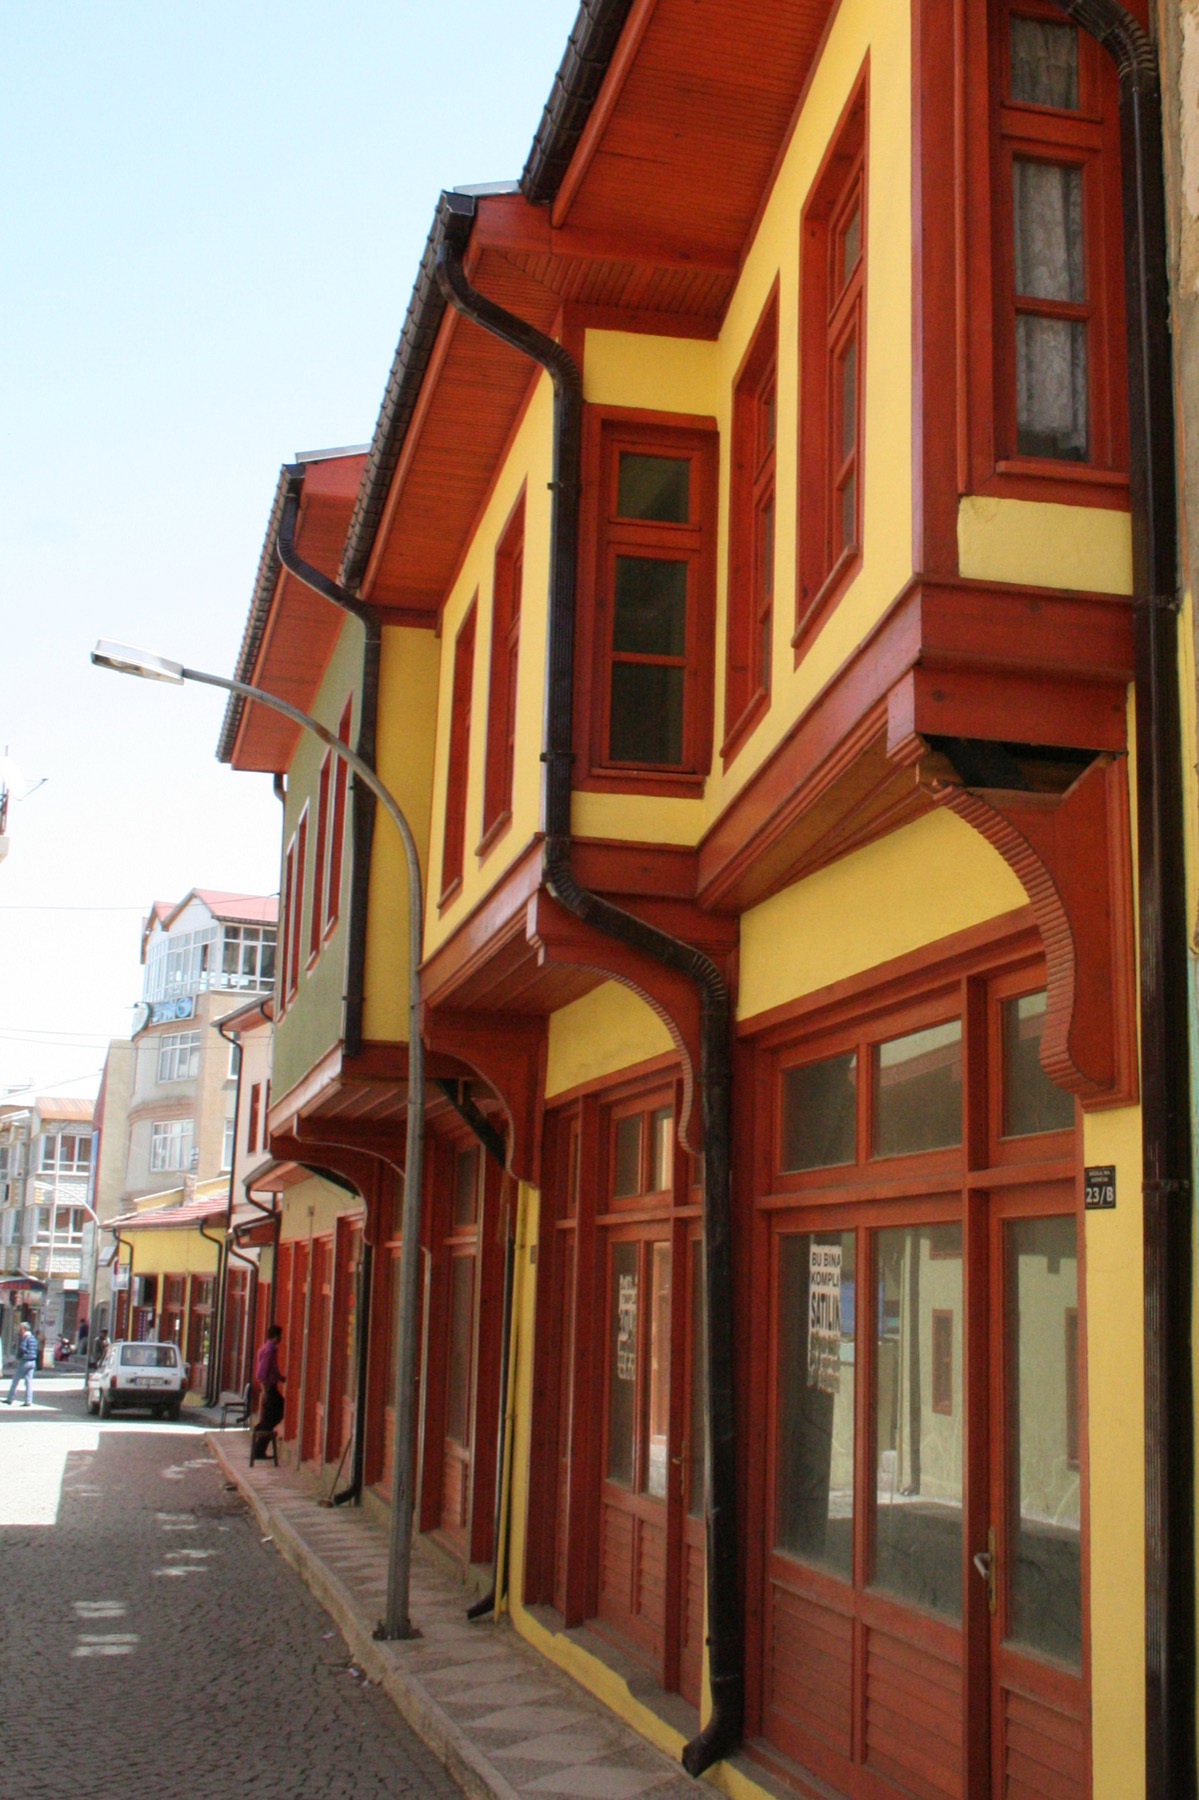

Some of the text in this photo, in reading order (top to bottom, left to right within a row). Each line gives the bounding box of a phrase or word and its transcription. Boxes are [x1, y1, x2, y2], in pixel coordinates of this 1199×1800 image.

[1085, 1186, 1114, 1205] 23/B
[811, 1252, 822, 1267] BU
[811, 1291, 841, 1332] SATILIK
